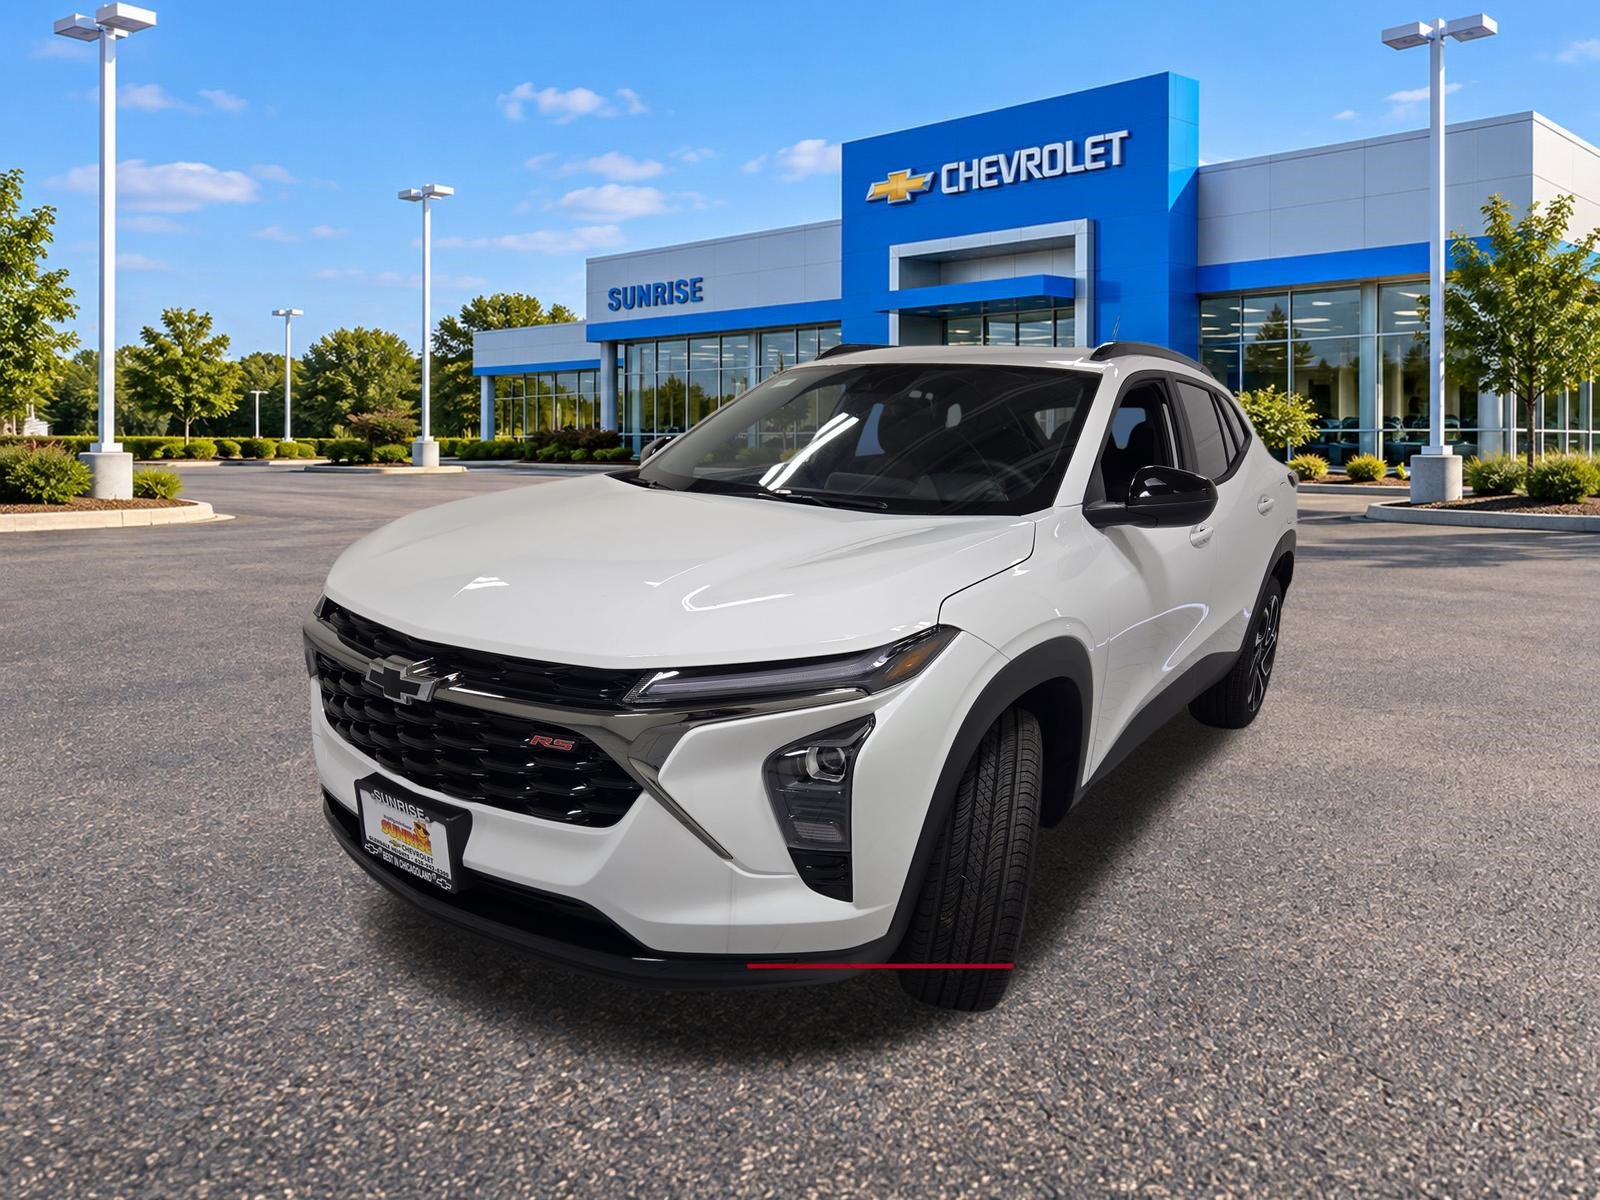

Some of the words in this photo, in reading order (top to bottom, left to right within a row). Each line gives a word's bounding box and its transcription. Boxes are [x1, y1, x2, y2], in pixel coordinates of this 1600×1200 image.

[941, 130, 1129, 193] CHEVROLET
[608, 277, 704, 312] SUNRISE
[530, 735, 576, 751] RS
[374, 789, 425, 818] SUNRISE
[401, 844, 434, 864] CHEVROLET
